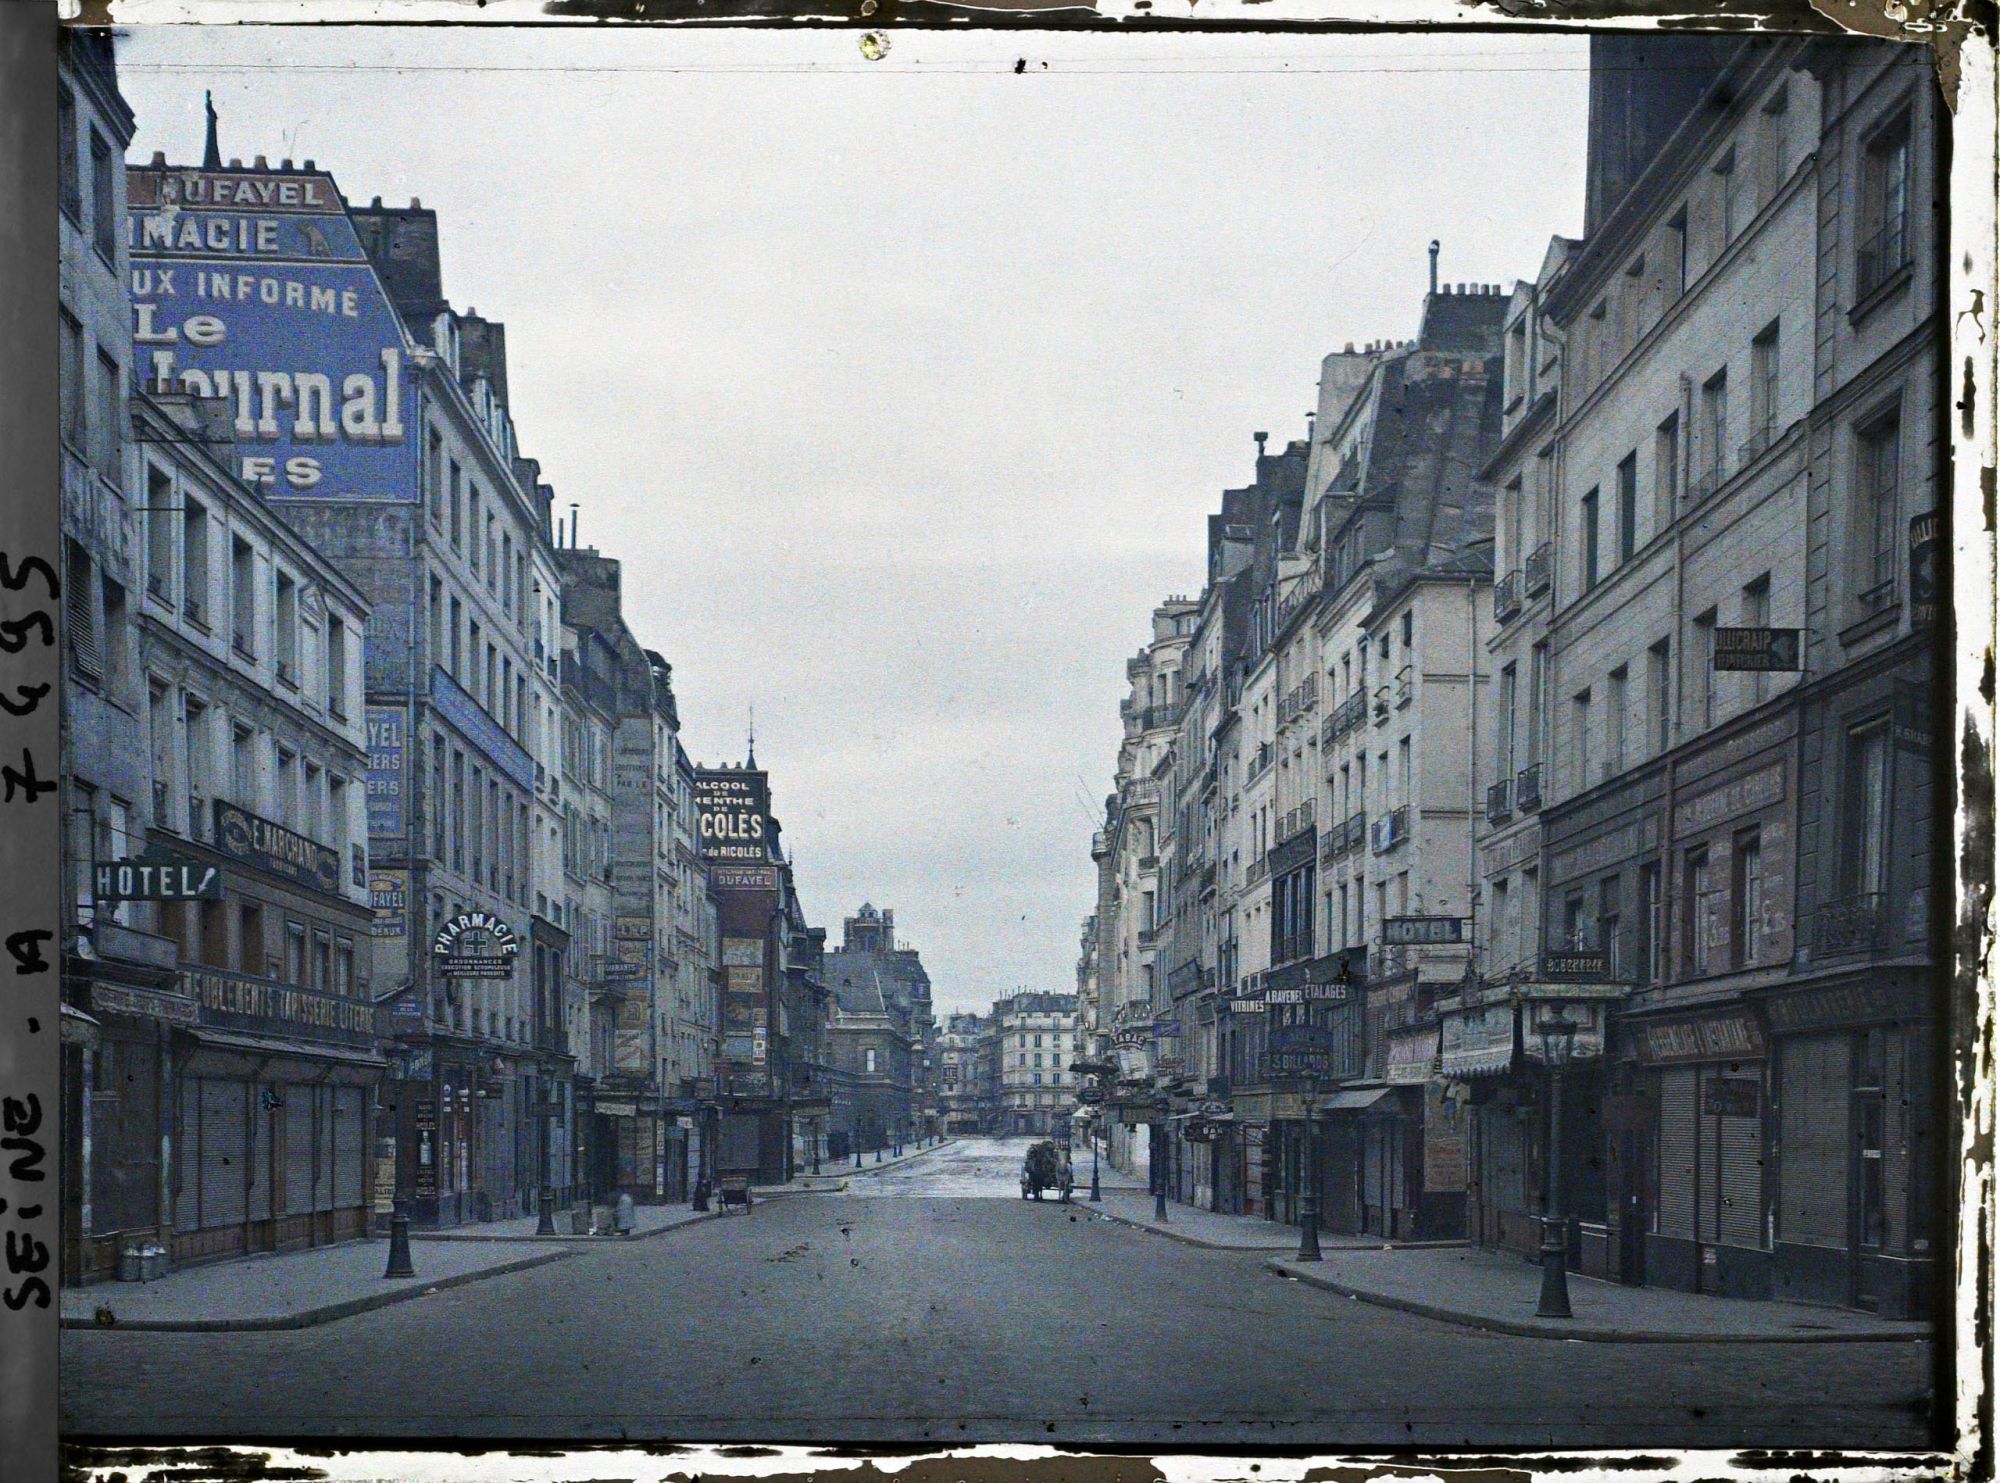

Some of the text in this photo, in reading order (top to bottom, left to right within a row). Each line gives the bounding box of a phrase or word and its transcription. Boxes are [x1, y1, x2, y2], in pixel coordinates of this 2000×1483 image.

[197, 271, 359, 317] INFORMÉ
[133, 303, 227, 347] Le
[97, 866, 197, 896] HOTEL
[718, 876, 771, 885] DUFAYEL
[434, 913, 518, 954] PHARMACIE
[1112, 1032, 1146, 1044] TABAC
